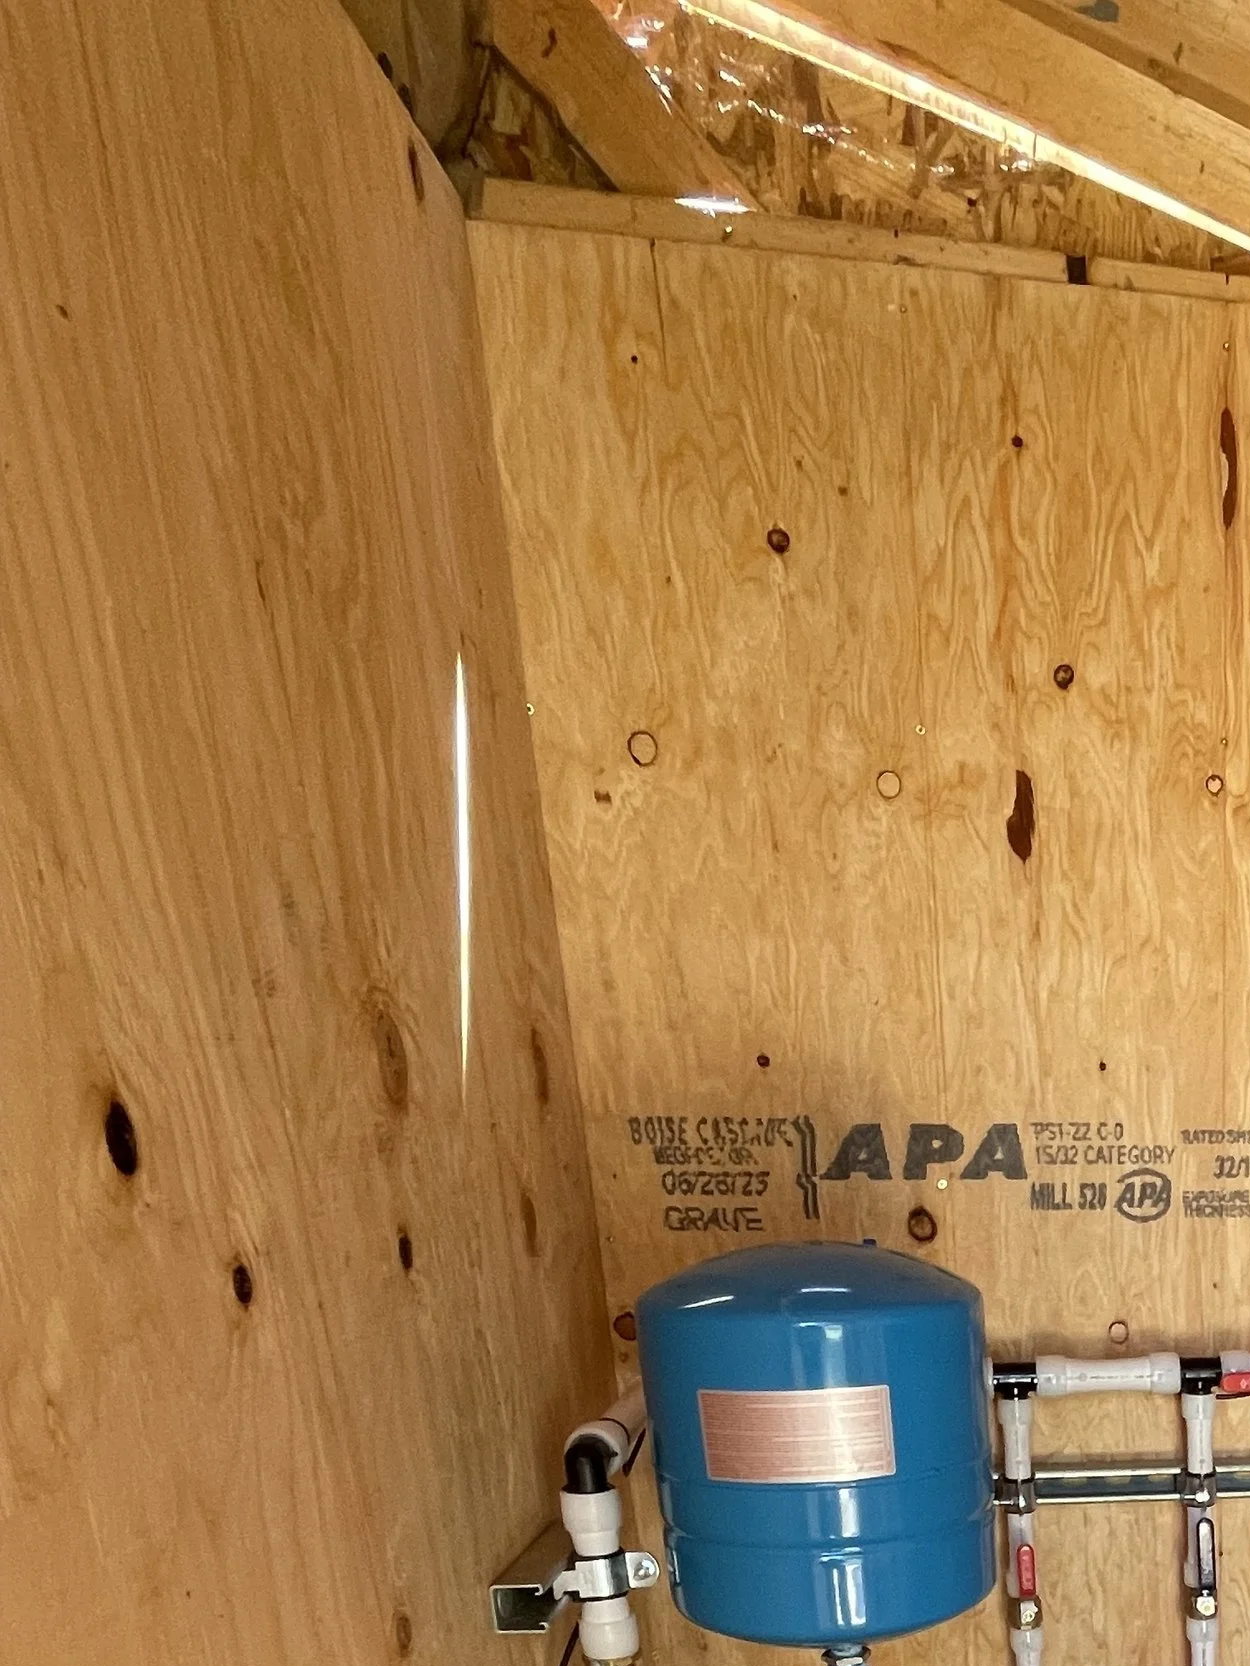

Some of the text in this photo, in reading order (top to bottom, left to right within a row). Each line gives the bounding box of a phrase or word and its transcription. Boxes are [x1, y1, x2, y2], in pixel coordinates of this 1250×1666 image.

[628, 1116, 689, 1146] BOISE
[820, 1122, 1029, 1181] APA
[1083, 1144, 1177, 1165] CATEGORY
[1030, 1181, 1073, 1210] MILL
[664, 1206, 766, 1233] GRAVE
